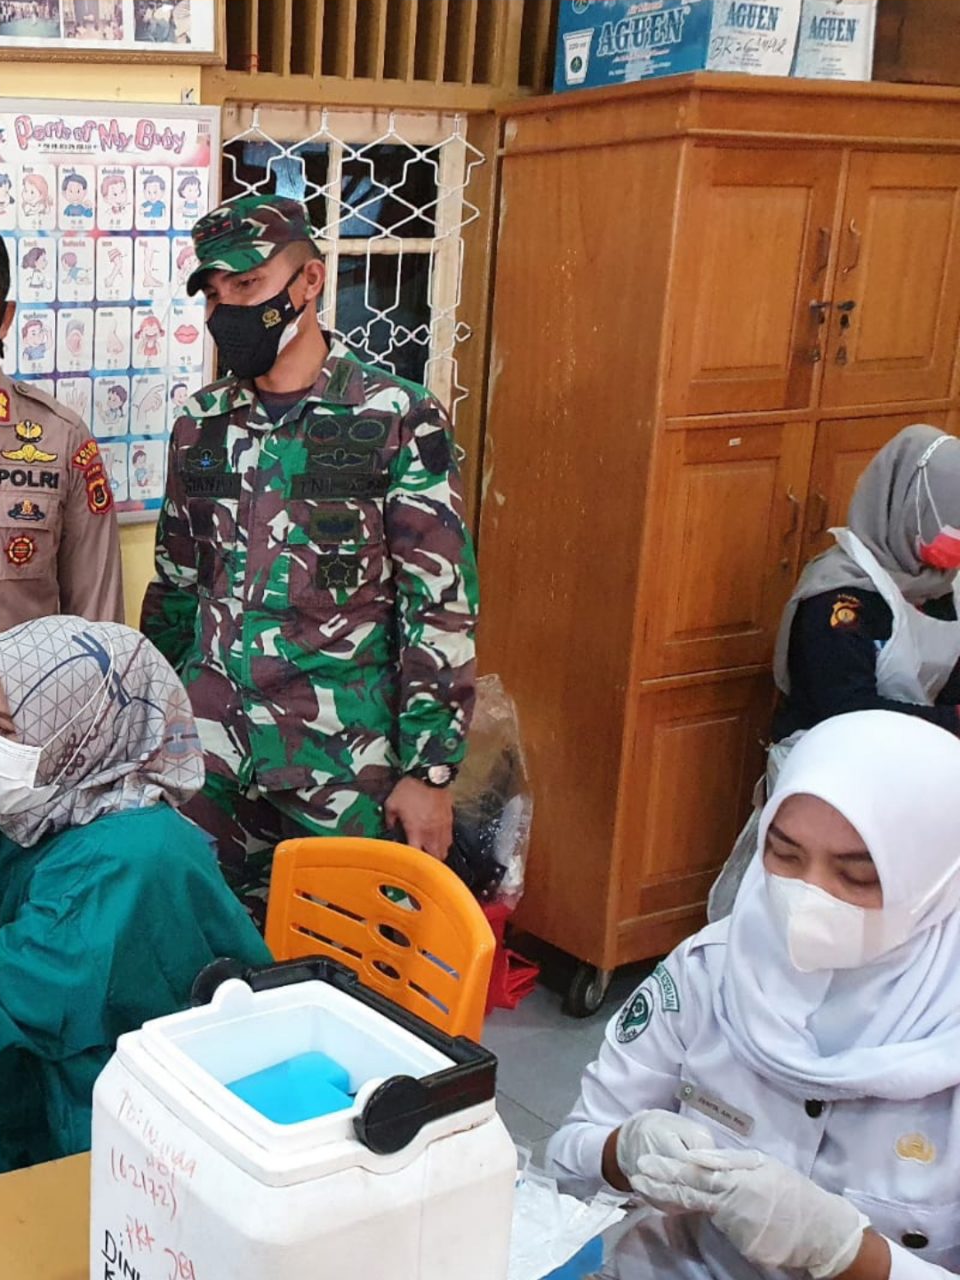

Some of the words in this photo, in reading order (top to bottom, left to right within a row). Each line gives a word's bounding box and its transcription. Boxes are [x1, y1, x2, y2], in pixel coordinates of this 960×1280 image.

[596, 7, 685, 57] AGUEN
[724, 1, 780, 32] AGUEN
[807, 15, 857, 43] AGUEN
[97, 118, 133, 153] My
[135, 119, 186, 154] Body
